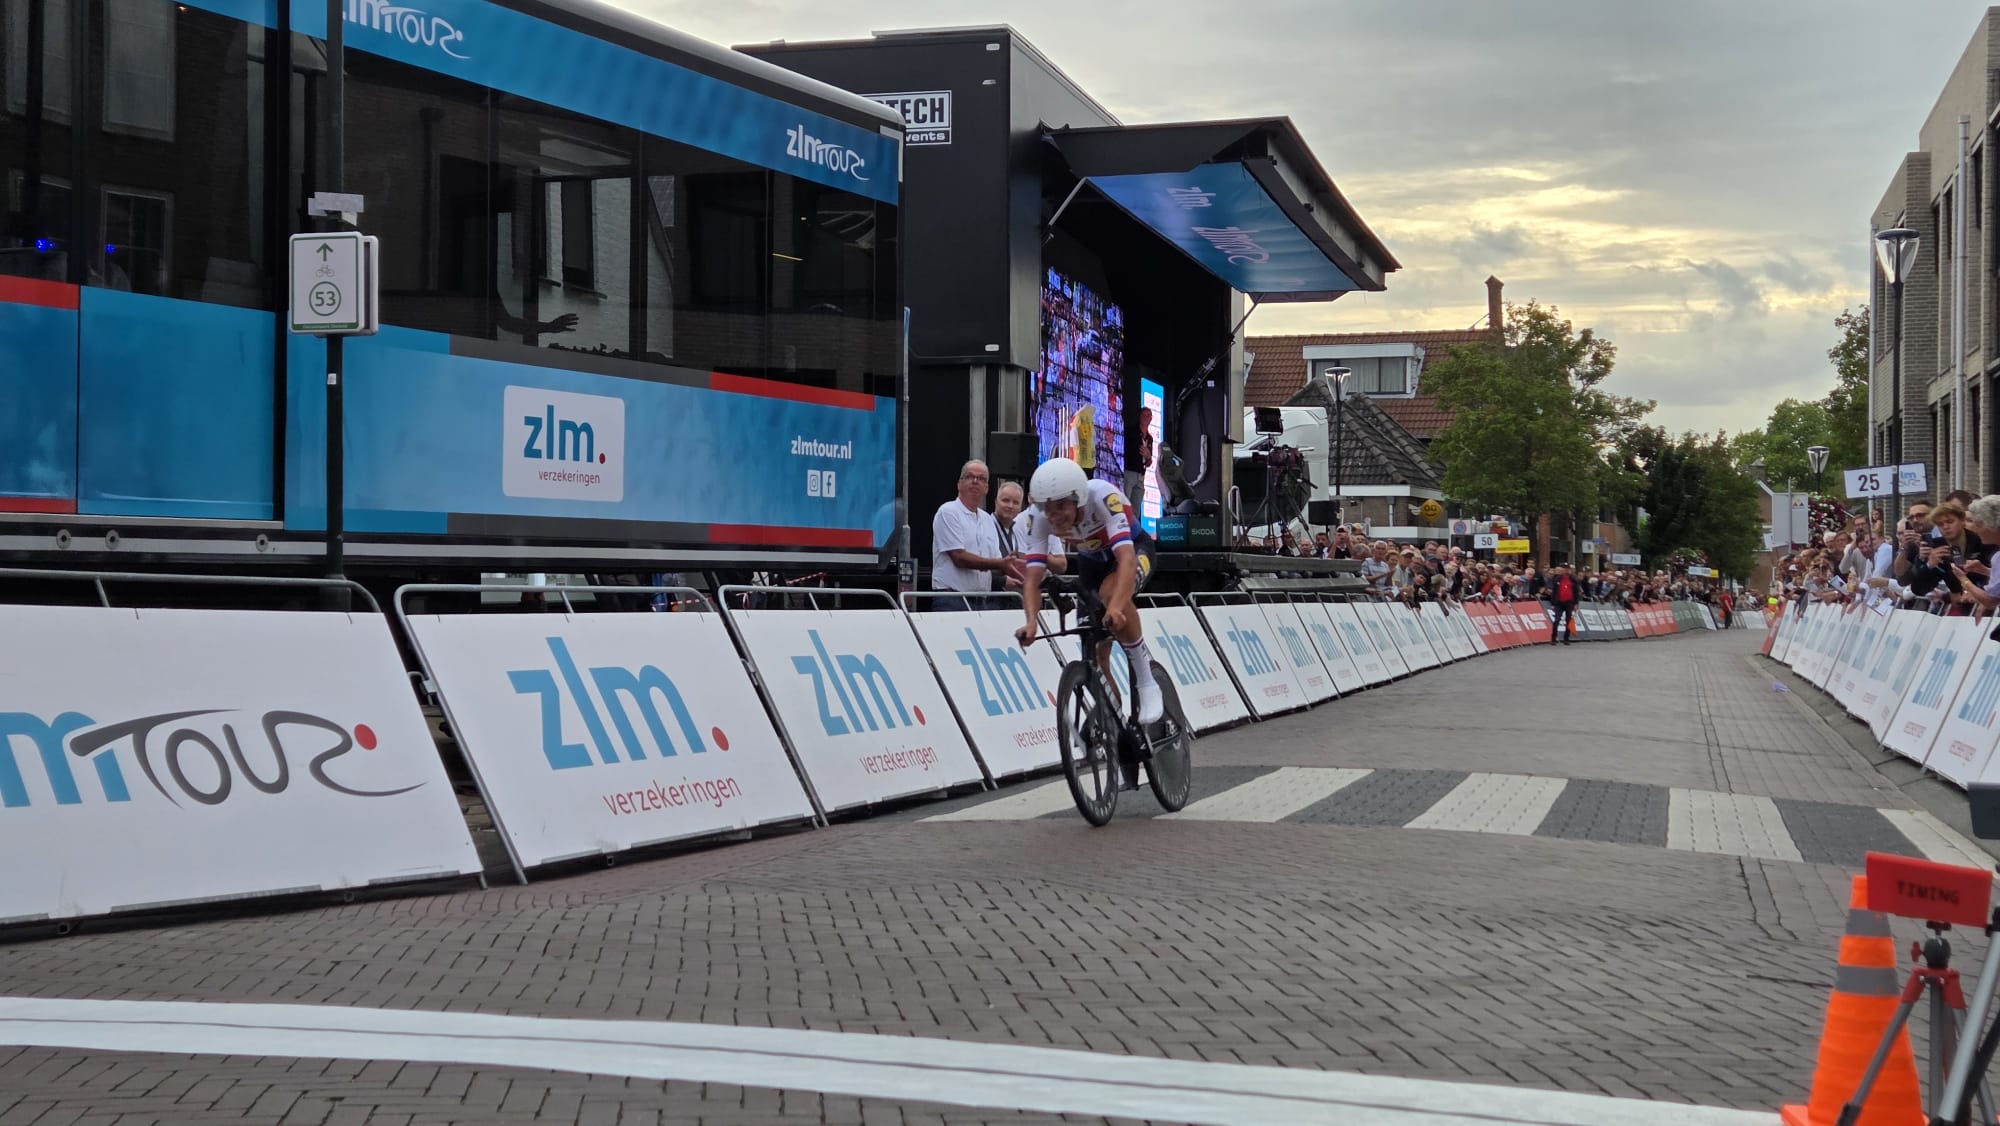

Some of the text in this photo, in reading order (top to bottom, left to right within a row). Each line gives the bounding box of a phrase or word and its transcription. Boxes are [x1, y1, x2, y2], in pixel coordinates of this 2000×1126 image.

[879, 97, 945, 124] TECH
[315, 291, 336, 307] 53
[791, 435, 852, 460] zlmtour.nl
[538, 469, 601, 487] verzekeringen
[1858, 473, 1880, 492] 25
[1481, 536, 1493, 546] 50
[859, 744, 938, 775] verzekeringen
[603, 776, 742, 816] verzekeringen
[1896, 880, 1960, 906] TIMING
